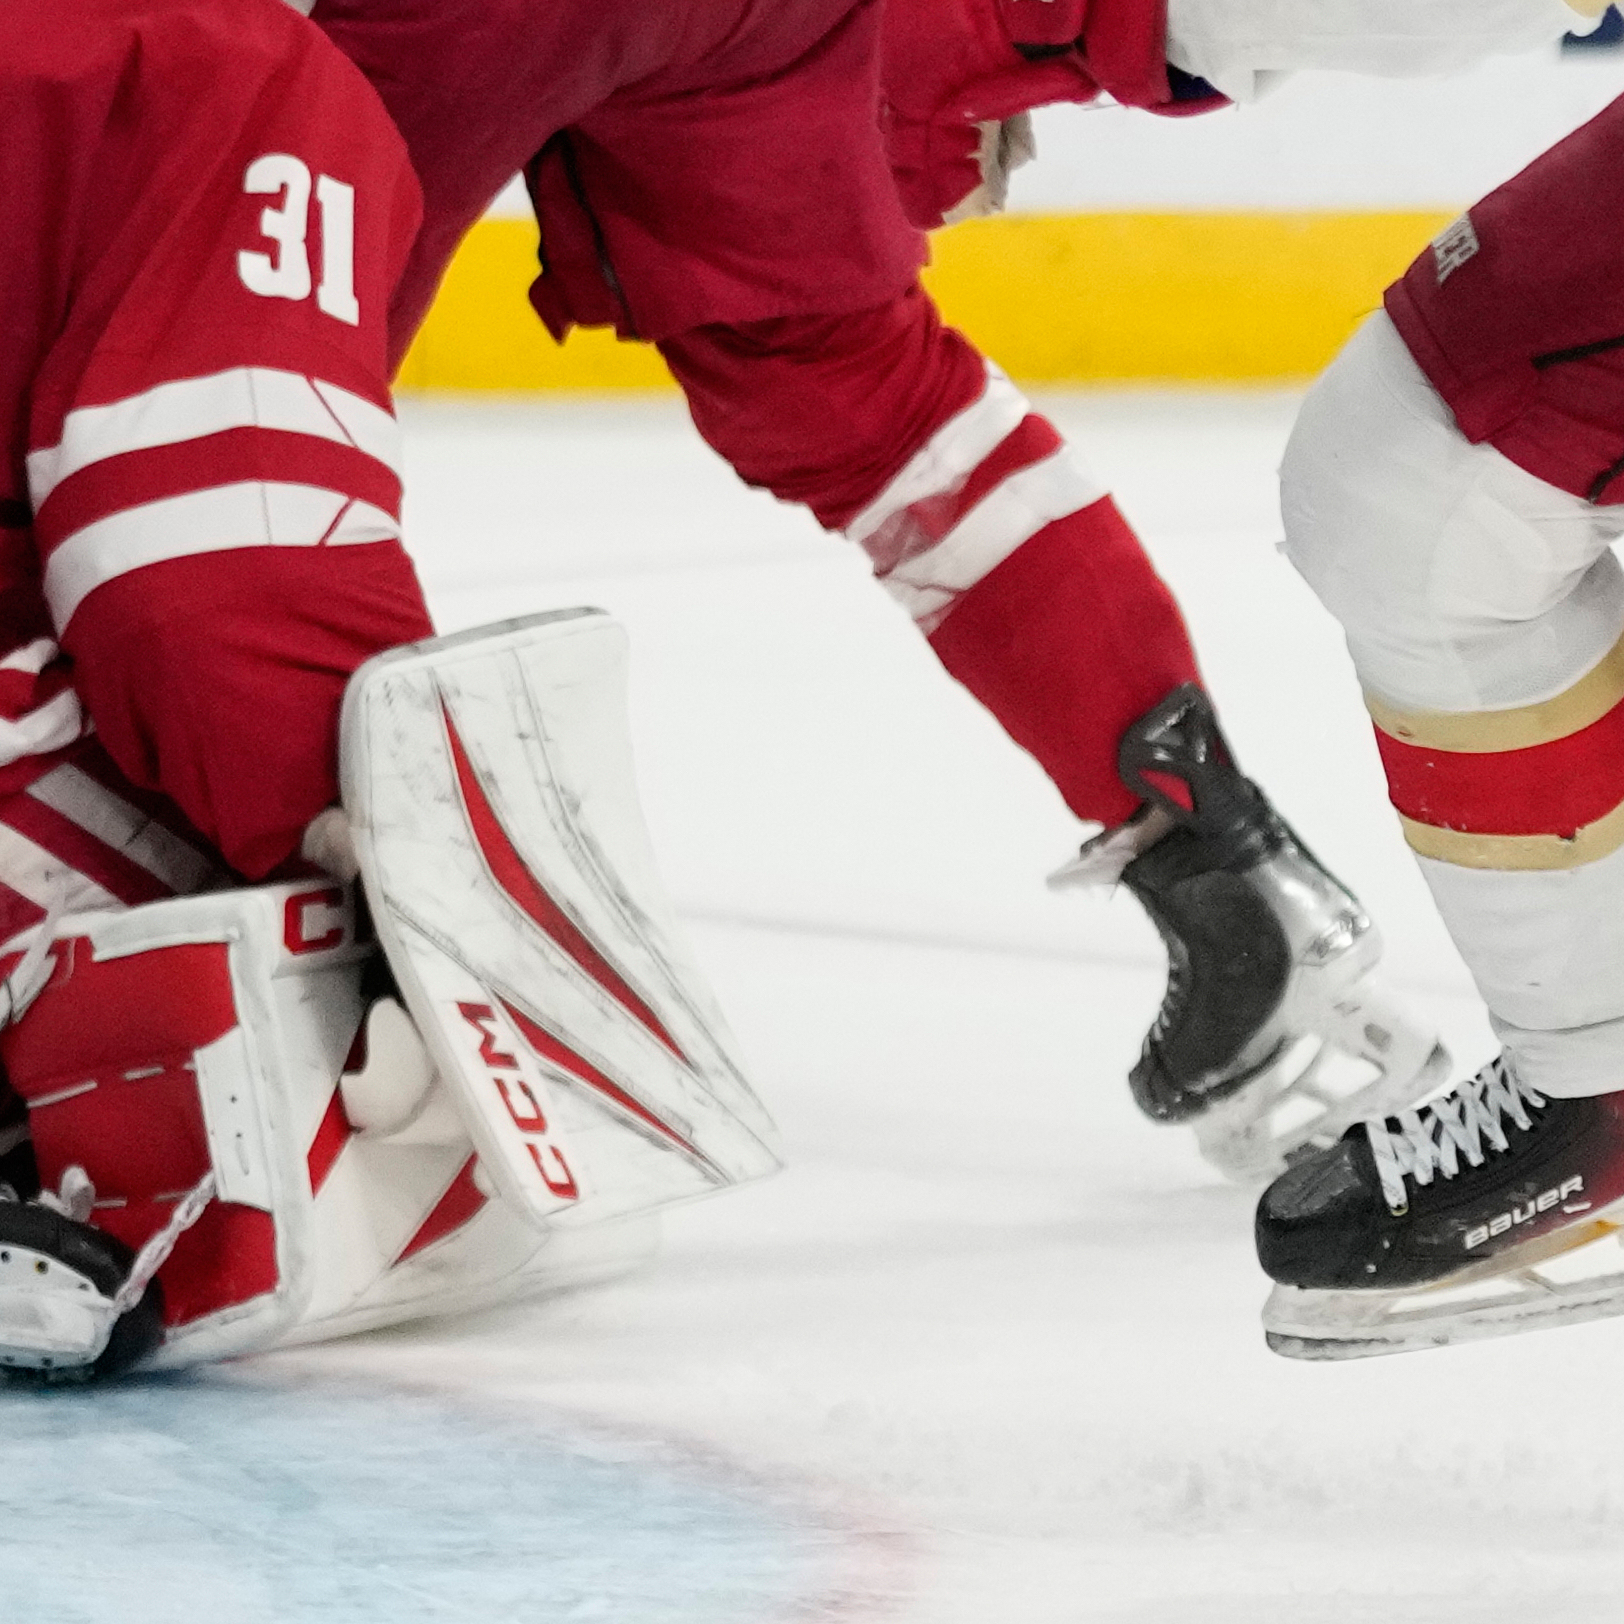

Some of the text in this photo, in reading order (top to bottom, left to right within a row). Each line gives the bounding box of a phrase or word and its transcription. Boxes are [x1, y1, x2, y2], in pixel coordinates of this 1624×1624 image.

[237, 153, 359, 326] 31
[455, 1000, 580, 1200] CCM
[1464, 1175, 1585, 1250] BAUER
